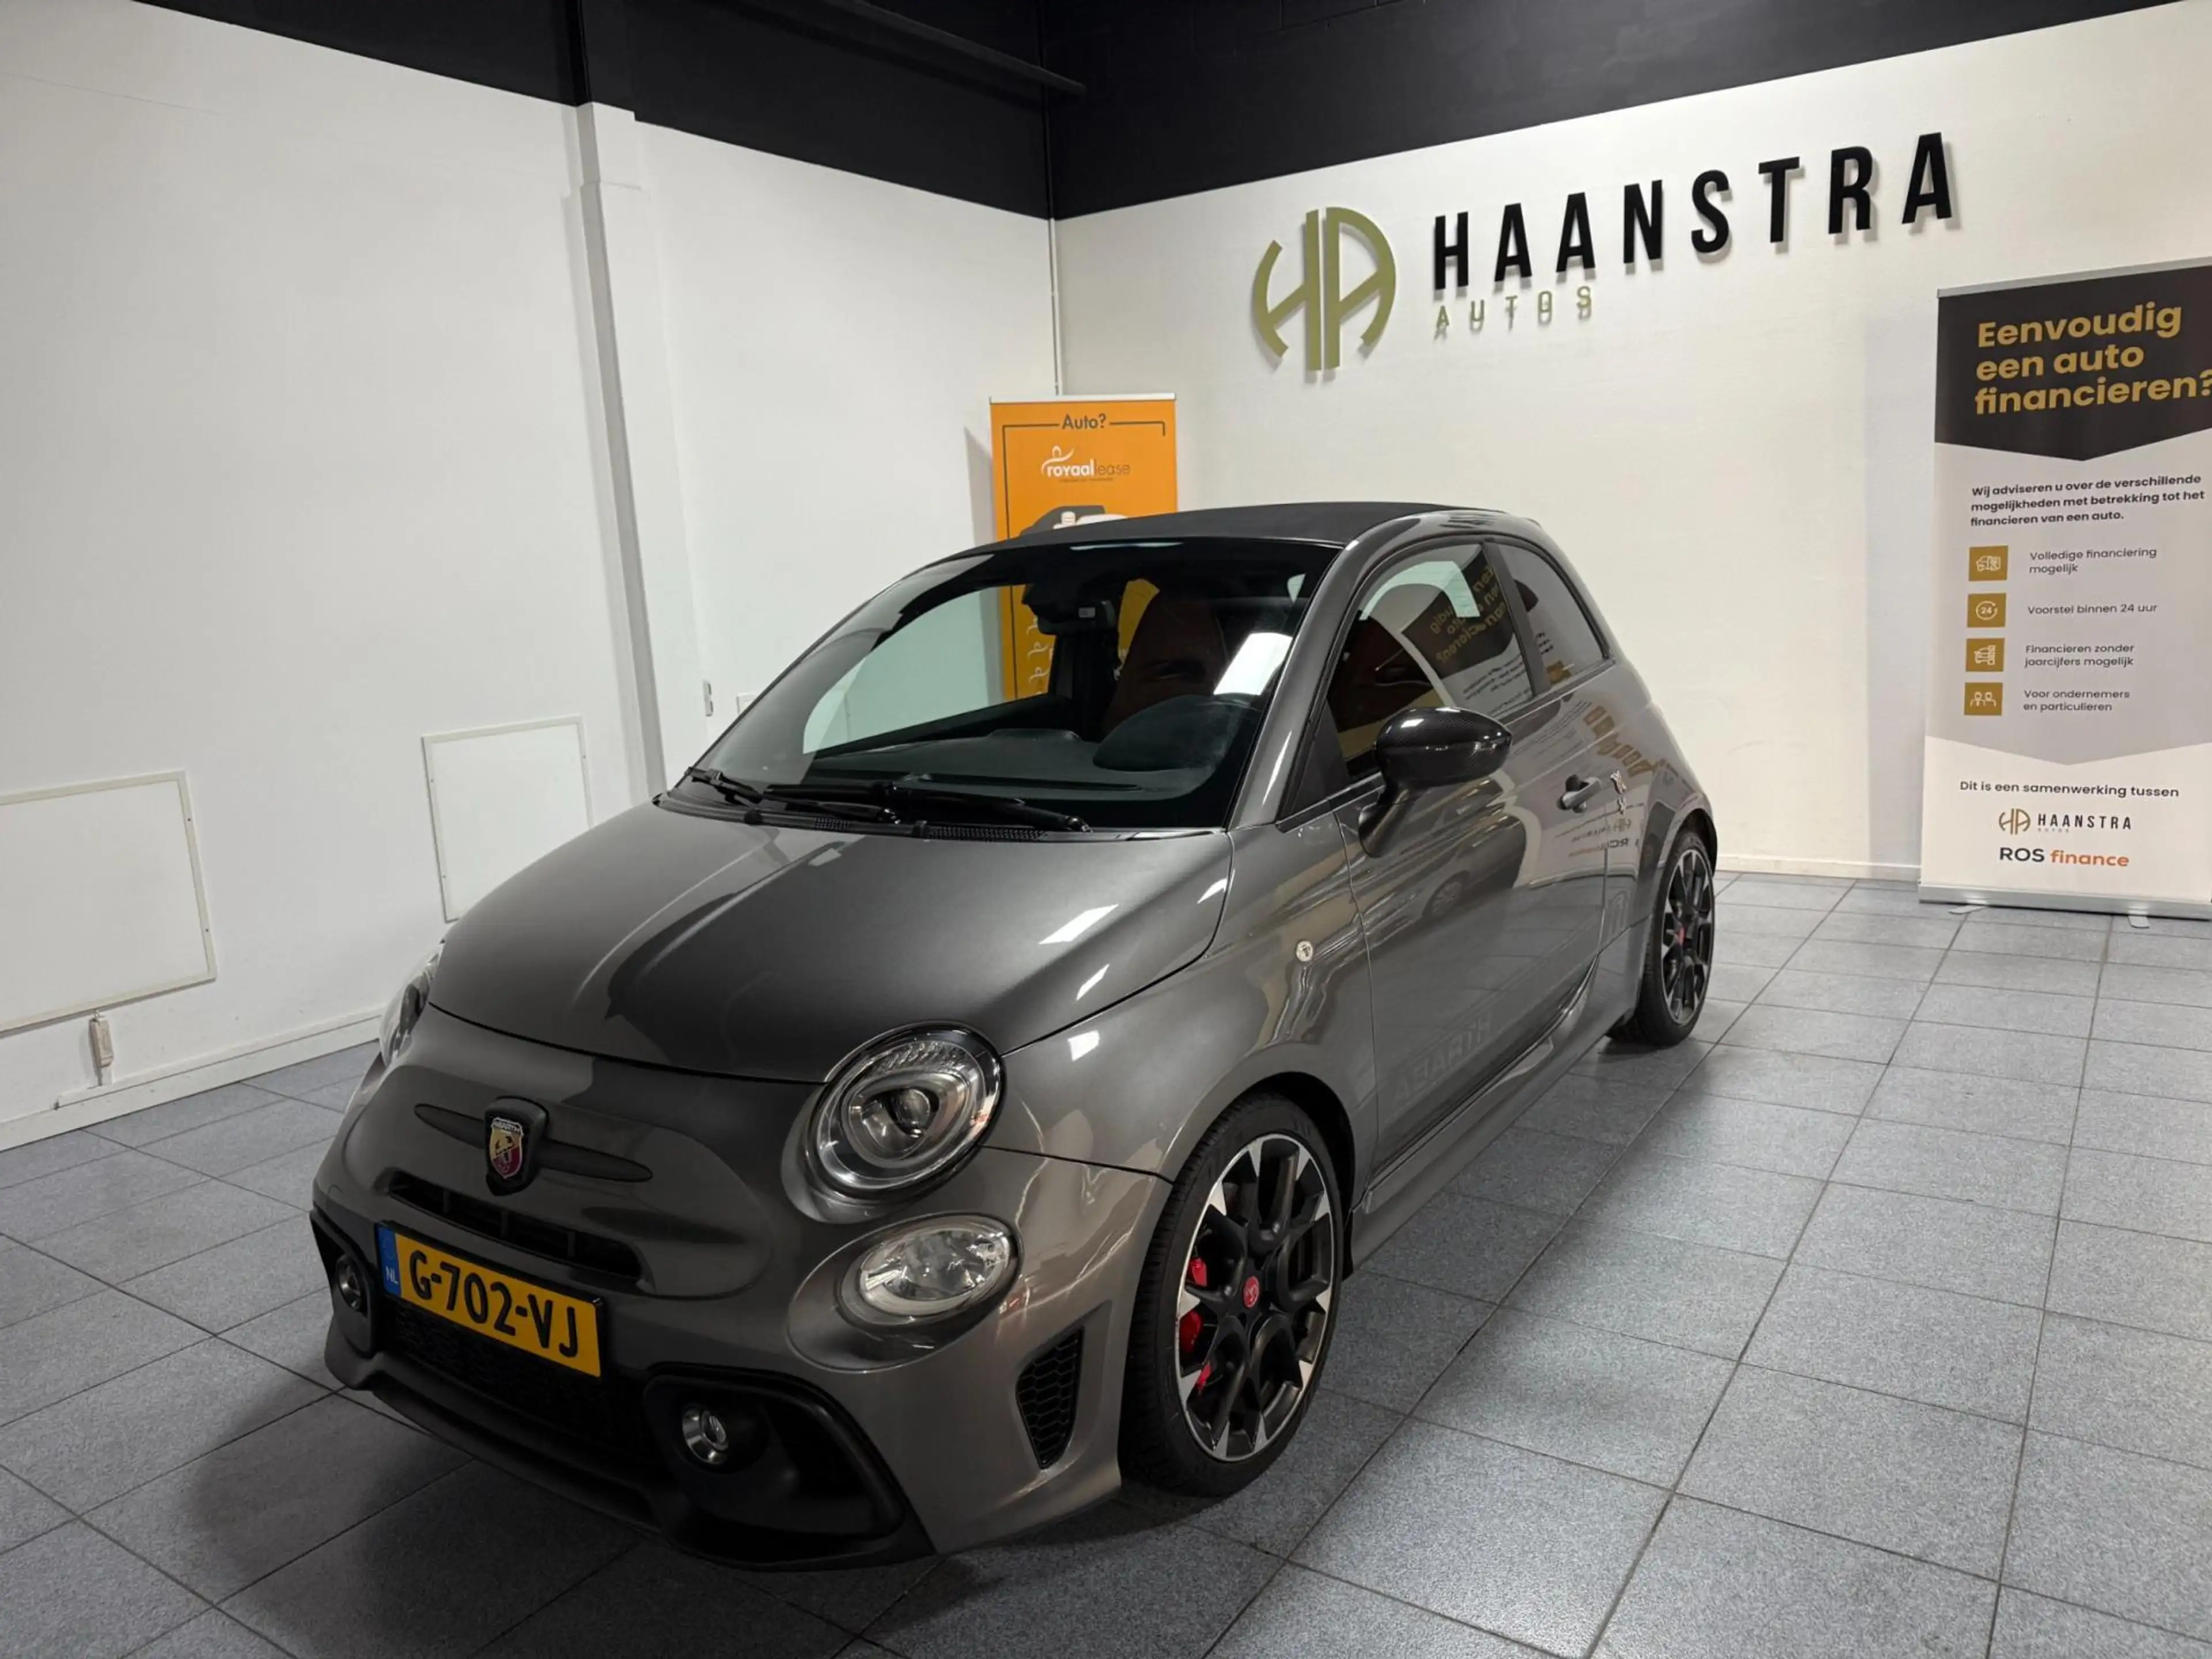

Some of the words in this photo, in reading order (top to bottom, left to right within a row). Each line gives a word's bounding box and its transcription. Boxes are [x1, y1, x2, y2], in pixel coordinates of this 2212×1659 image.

[1432, 132, 1953, 290] HAANSTRA
[1433, 284, 1593, 329] AUTOS
[1978, 301, 2182, 348] Eenvoudig
[1976, 355, 2044, 381] een
[2053, 344, 2145, 374] auto
[1975, 369, 2212, 415] financieren?
[1062, 413, 1107, 430] Auto?
[1972, 486, 1990, 498] Wij
[1992, 482, 2053, 496] adviseren
[2055, 483, 2063, 492] u
[2065, 480, 2094, 491] over
[2096, 479, 2112, 489] de
[2114, 474, 2202, 488] verschillende
[1971, 498, 2061, 514] mogelijkheden
[2063, 496, 2088, 507] met
[2090, 491, 2160, 506] betrekking
[2162, 491, 2181, 502] tot
[2183, 490, 2206, 501] het
[1971, 514, 2039, 527] financieren
[2040, 514, 2065, 524] van
[2066, 512, 2090, 522] een
[2092, 510, 2124, 521] auto.
[2029, 550, 2084, 562] Volledige
[2086, 547, 2158, 559] financiering
[2029, 563, 2079, 575] mogelijk
[1980, 605, 1993, 615] 24
[2028, 605, 2074, 615] Voorstel
[2077, 604, 2118, 614] binnen
[2120, 603, 2134, 613] 24
[2137, 604, 2158, 612] uur
[2025, 643, 2092, 654] Financieren
[2094, 643, 2135, 653] zonder
[2024, 657, 2081, 669] jaarcijfers
[2084, 656, 2134, 668] mogelijk
[2024, 690, 2050, 699] Voor
[2052, 689, 2130, 699] ondernemers
[2023, 702, 2037, 711] en
[2040, 702, 2113, 713] particulieren
[1960, 780, 1978, 791] Dit
[1980, 781, 1992, 792] is
[1994, 782, 2020, 793] een
[2022, 783, 2127, 798] samenwerking
[2130, 786, 2180, 798] tussen
[2037, 812, 2132, 830] HAANSTRA
[1999, 847, 2045, 863] ROS
[2050, 849, 2130, 868] finance
[385, 1266, 399, 1285] NL
[409, 1250, 578, 1358] G-702-VJ
